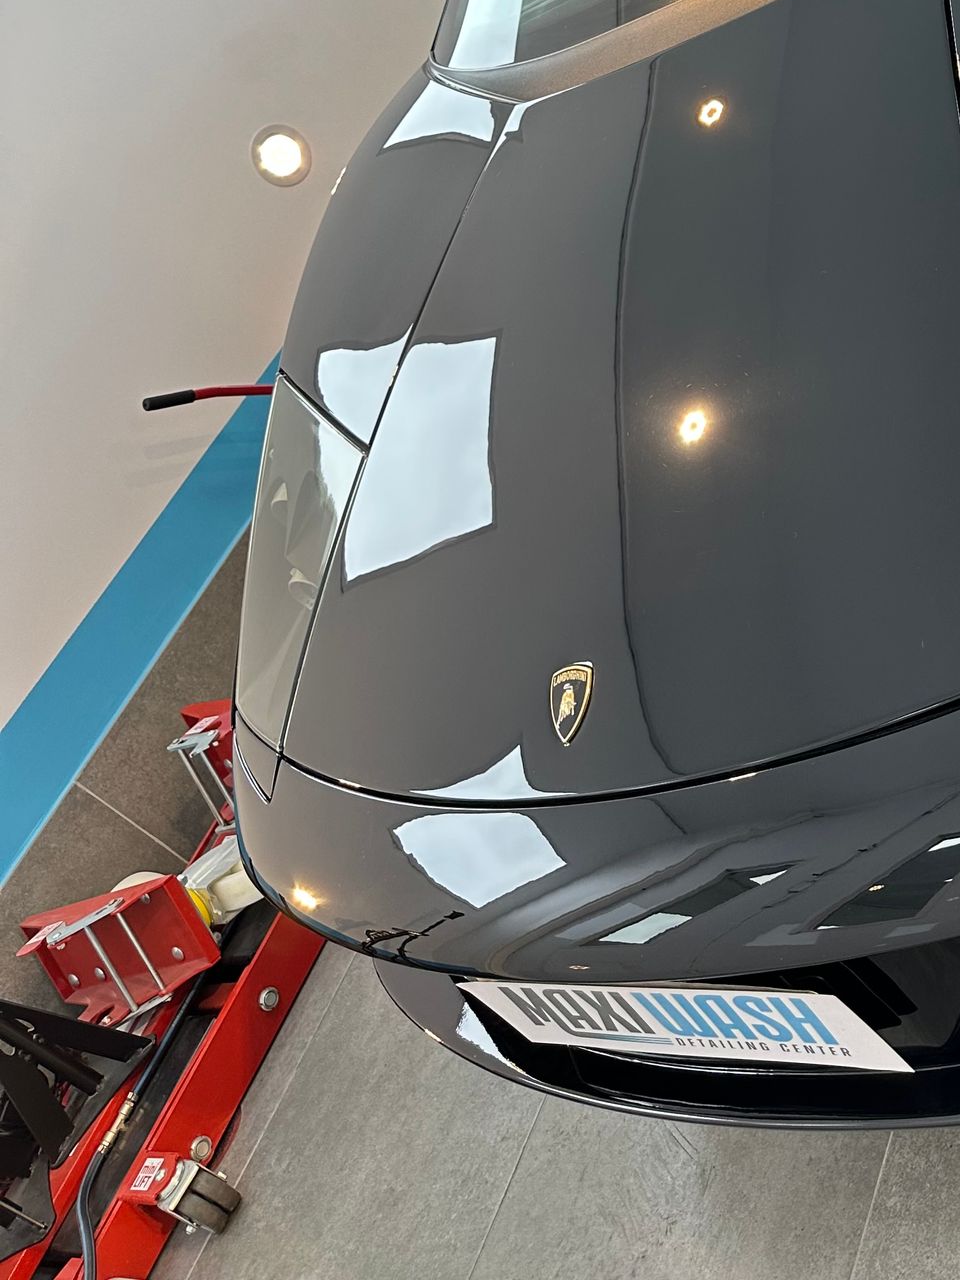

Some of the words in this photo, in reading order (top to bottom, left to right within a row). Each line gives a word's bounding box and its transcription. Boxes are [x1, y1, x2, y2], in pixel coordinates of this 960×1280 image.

[497, 986, 656, 1036] MAXI
[630, 992, 839, 1045] WASH
[676, 1037, 770, 1052] DETAILING
[780, 1042, 852, 1057] CENTER
